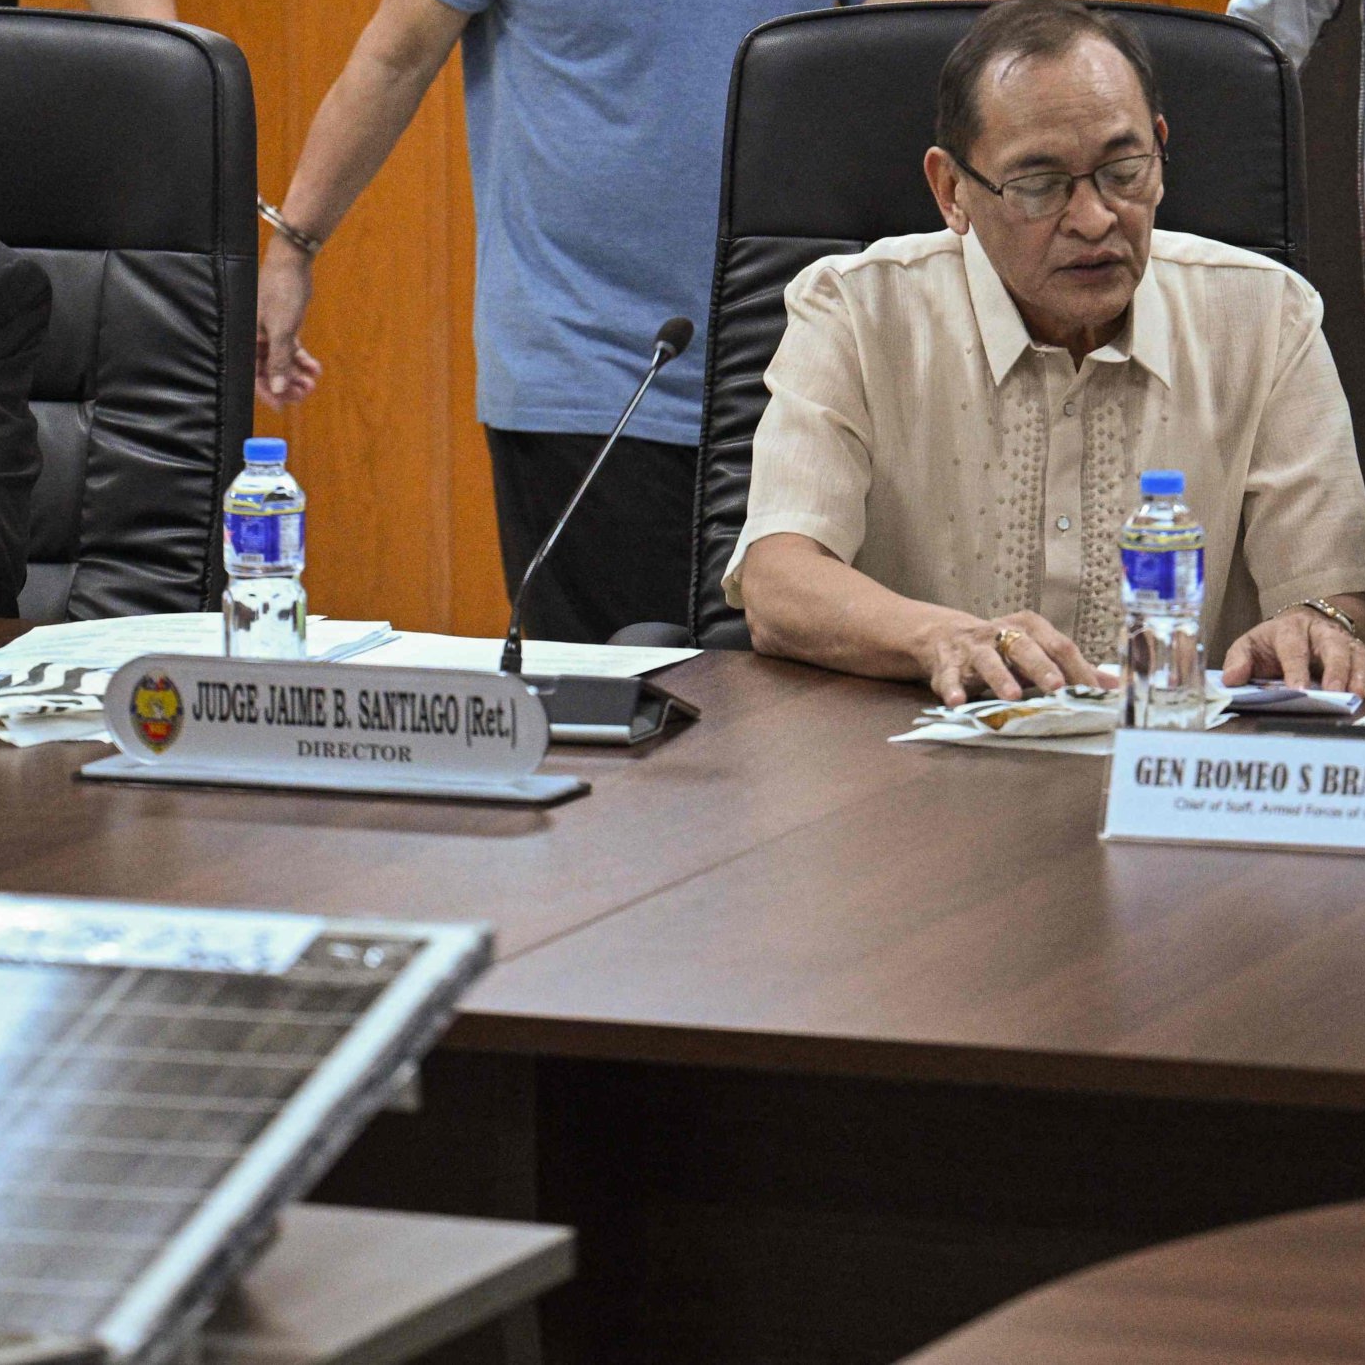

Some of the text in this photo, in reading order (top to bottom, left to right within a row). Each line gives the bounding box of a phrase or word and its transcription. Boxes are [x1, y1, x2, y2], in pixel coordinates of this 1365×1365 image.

[192, 681, 517, 748] JUDGE JAIME B. SANTIAGO (Ret.)
[297, 739, 413, 763] DIRECTOR
[1135, 756, 1184, 788] GEN
[1195, 760, 1289, 795] ROMEO
[1298, 763, 1313, 794] S
[1174, 796, 1206, 811] Chief
[1209, 800, 1223, 812] of
[1260, 803, 1301, 817] Armed
[1305, 805, 1342, 819] Forces
[1346, 808, 1361, 820] of
